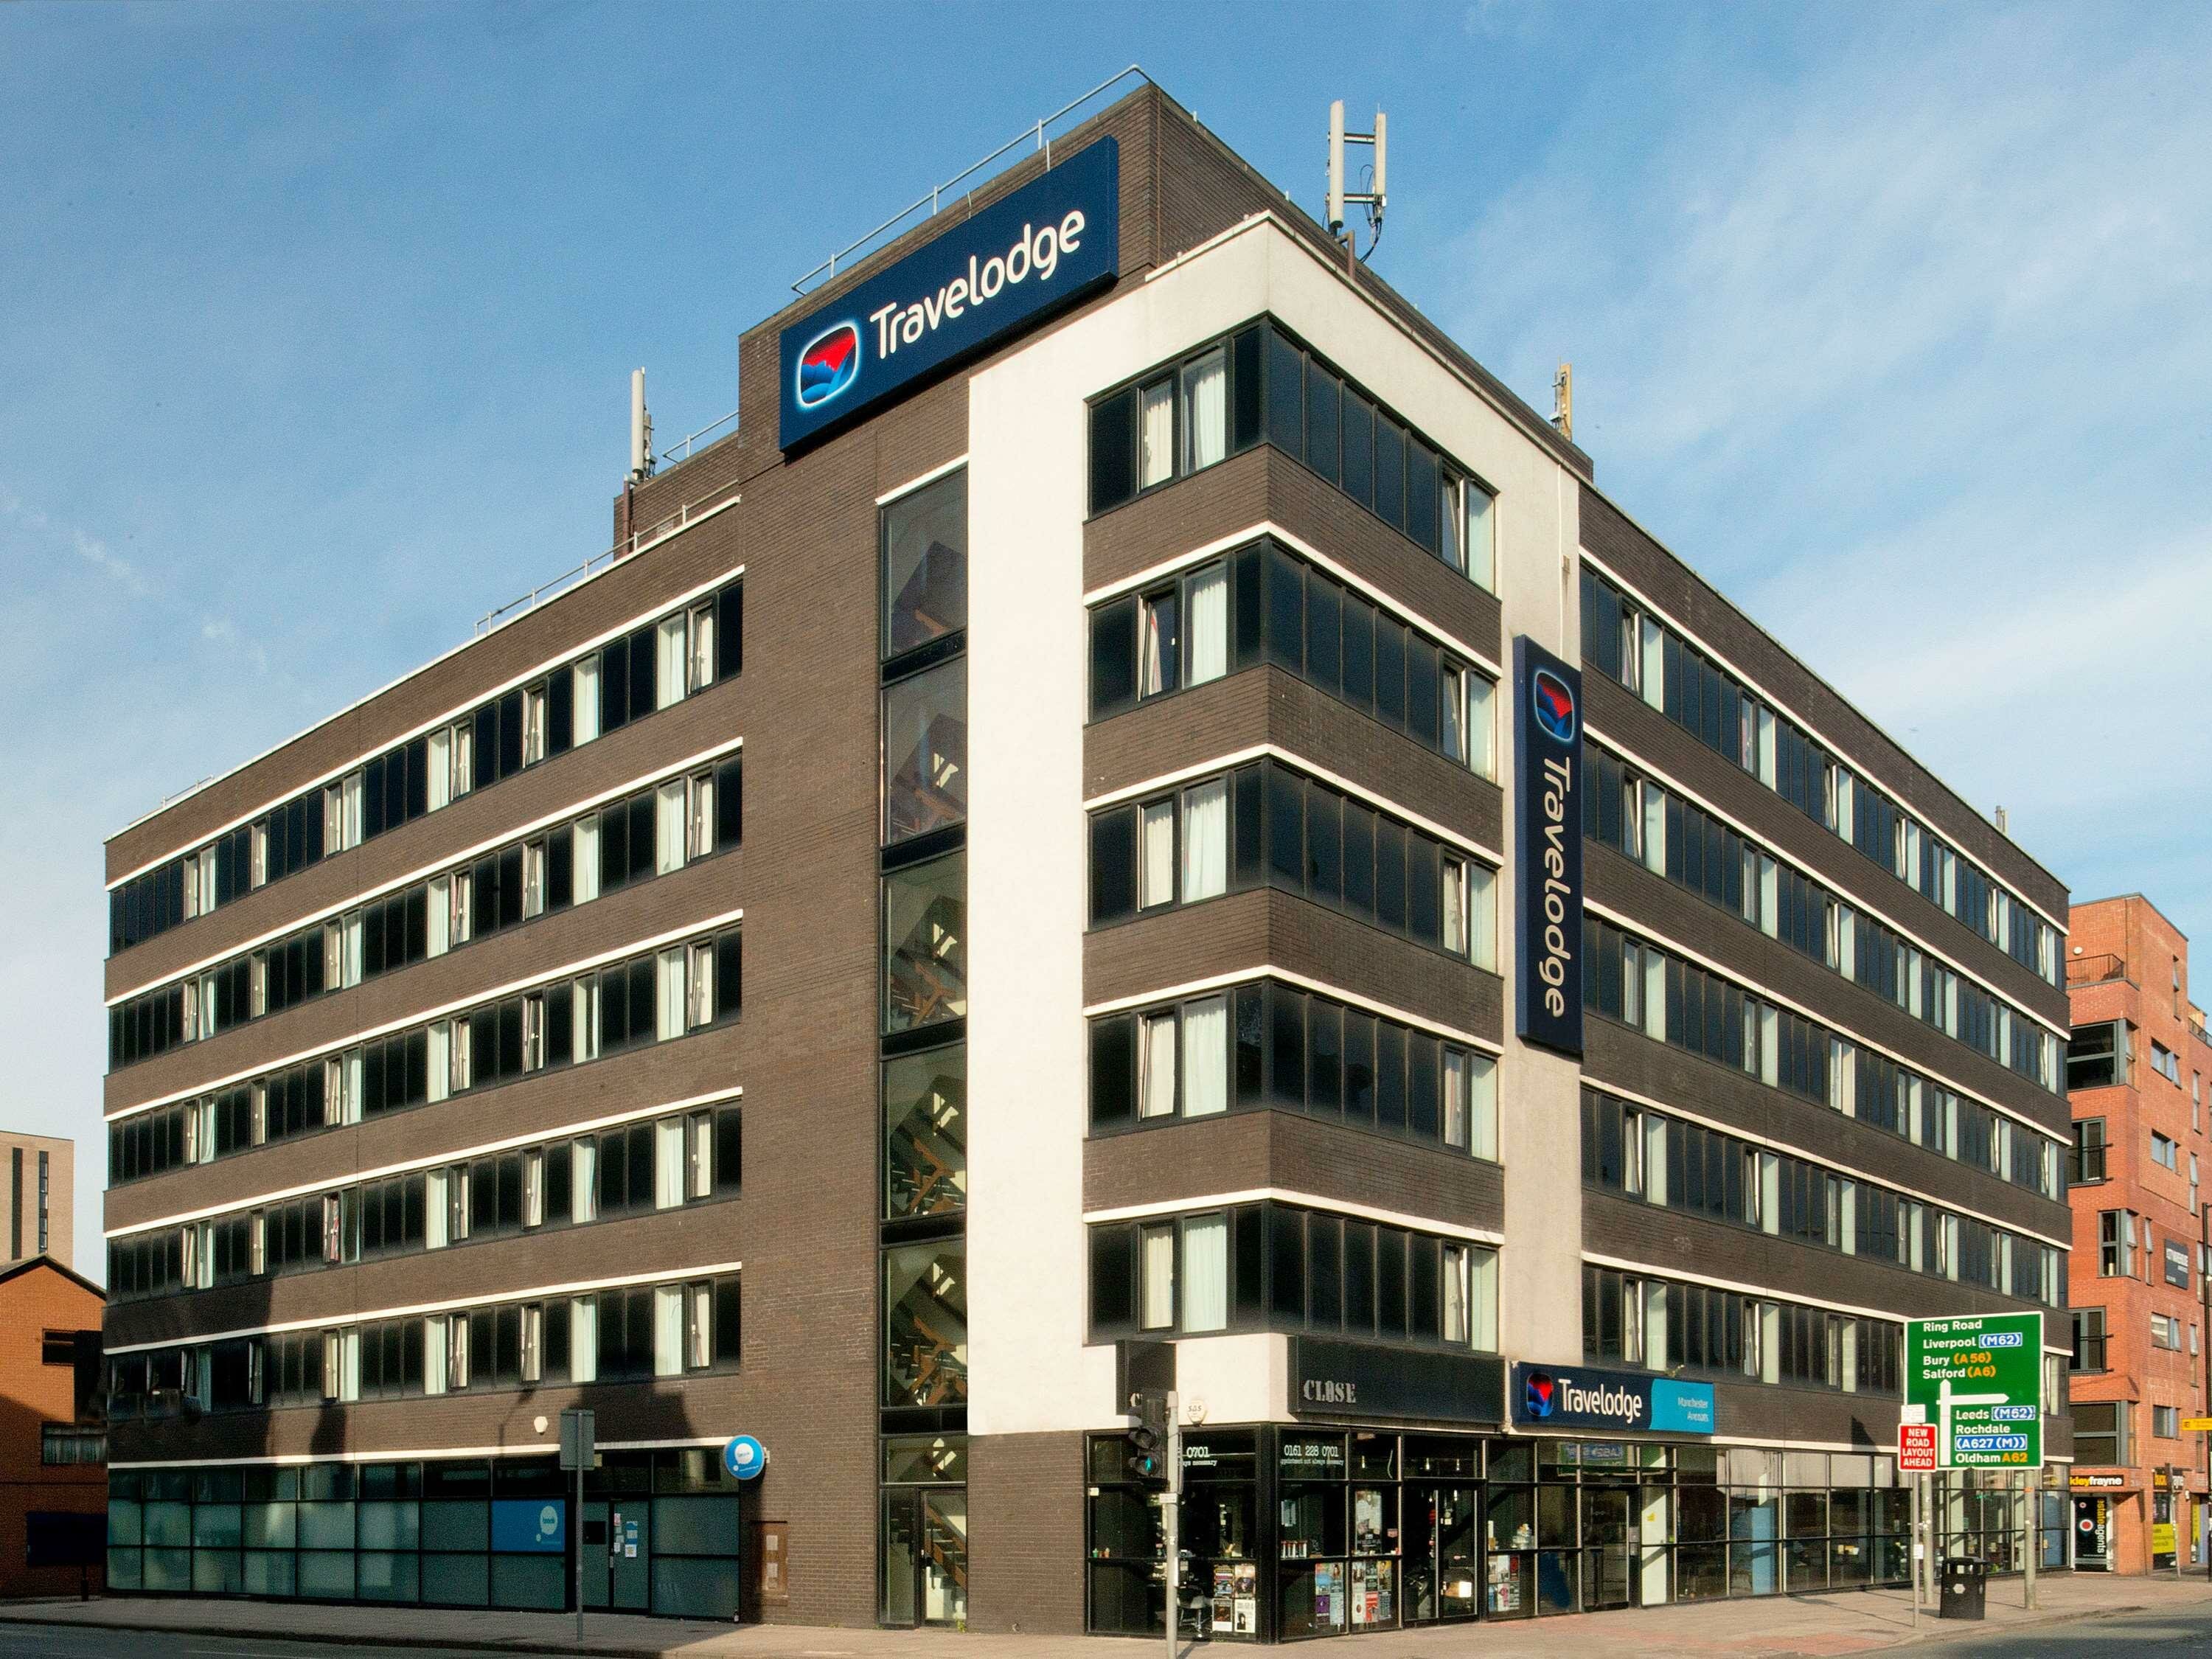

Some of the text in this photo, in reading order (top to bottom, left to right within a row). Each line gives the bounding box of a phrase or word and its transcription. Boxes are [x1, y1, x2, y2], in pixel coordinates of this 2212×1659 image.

[869, 209, 1085, 359] Travelodge
[1539, 757, 1571, 1018] Travelodge
[1923, 1320, 1982, 1333] Ring Road
[1923, 1338, 1976, 1349] Liverpool
[1923, 1355, 1950, 1366] Bury
[1923, 1366, 1996, 1379] Salford (A6)
[1558, 1378, 1642, 1424] Travelodge
[1677, 1397, 1708, 1408] Manchester
[1955, 1409, 1989, 1420] Leeds
[1908, 1428, 1928, 1437] NEW
[1955, 1424, 2010, 1434] Rochdale
[1906, 1438, 1930, 1447] ROAD
[1186, 1447, 1210, 1458] 0701
[1284, 1445, 1339, 1457] 0161 228 0701
[1902, 1447, 1933, 1457] LAYOUT
[1903, 1458, 1933, 1467] AHEAD
[1955, 1453, 2000, 1464] Oldham
[2070, 1476, 2122, 1486] kleyfrayne
